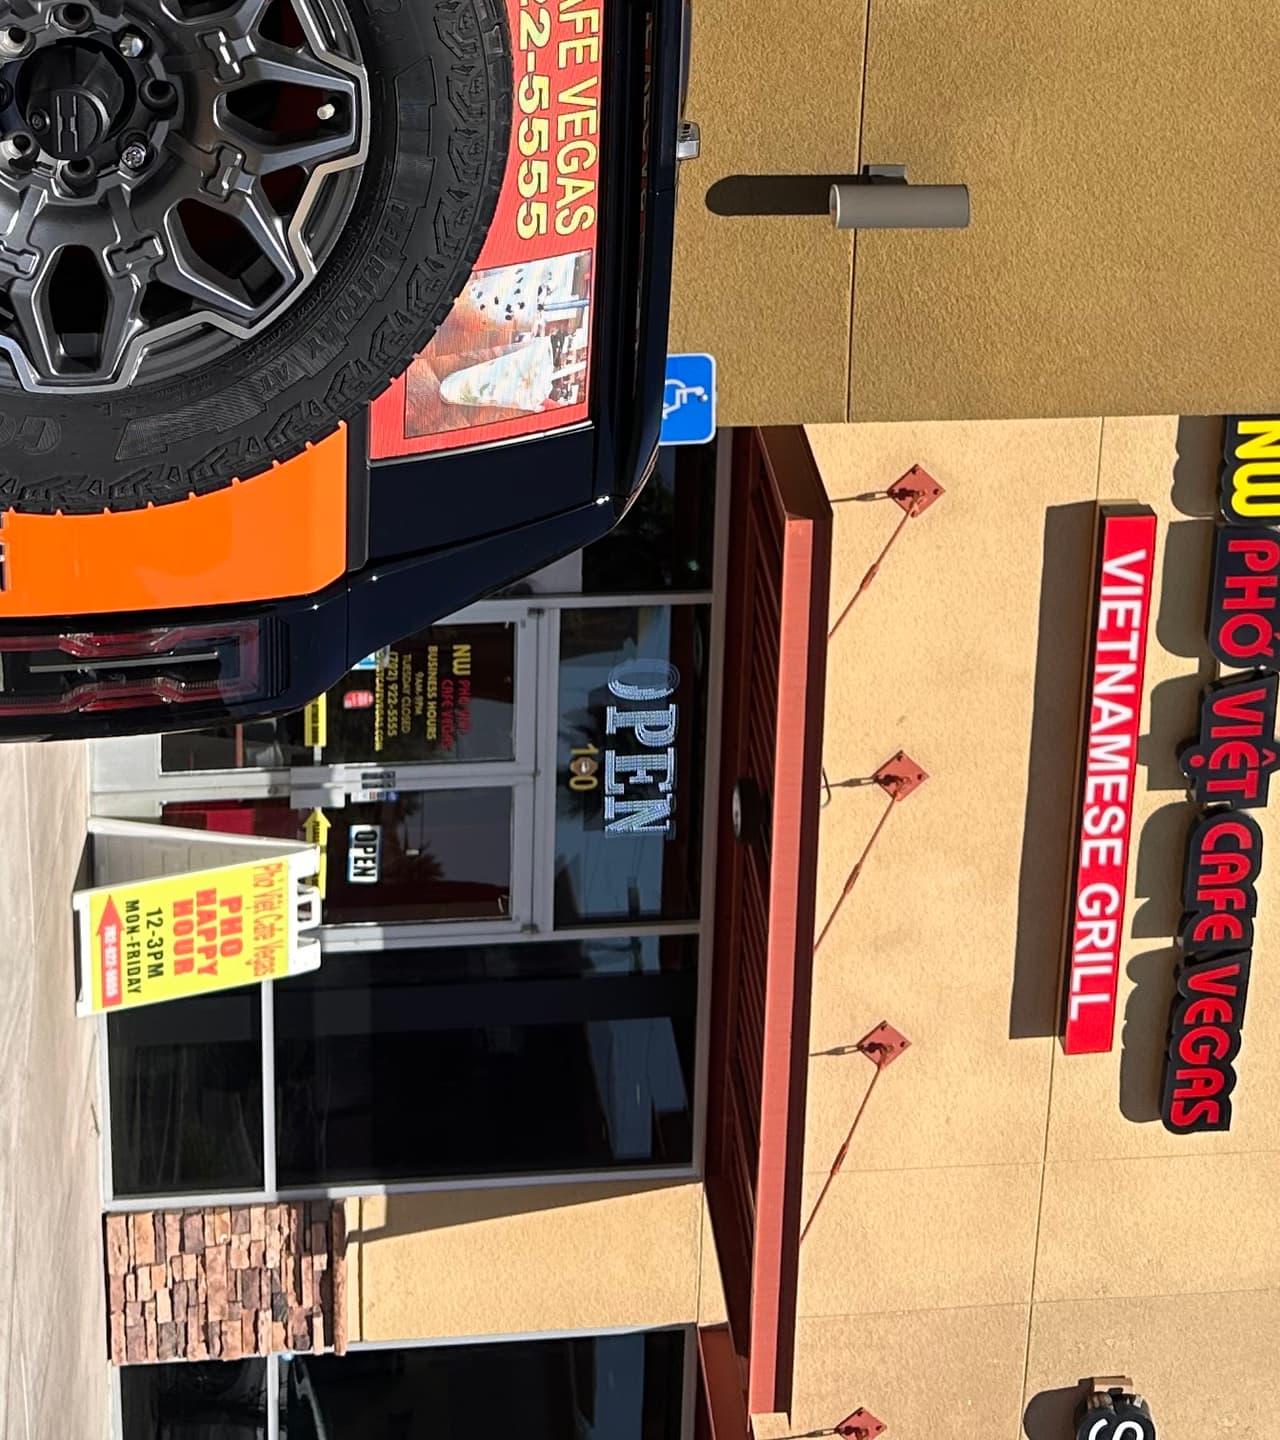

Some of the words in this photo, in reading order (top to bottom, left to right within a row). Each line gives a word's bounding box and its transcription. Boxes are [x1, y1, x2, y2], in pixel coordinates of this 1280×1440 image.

[554, 78, 598, 236] VEGAS
[386, 651, 399, 681] (702)
[402, 654, 412, 695] TUESDAY
[427, 645, 439, 699] BUSINESS
[452, 644, 471, 676] NW
[387, 683, 398, 737] 922-5555
[401, 696, 411, 734] CLOSED
[441, 679, 454, 707] CAFE
[1080, 549, 1147, 866] VIETNAMESE
[426, 701, 437, 740] HOURS
[441, 709, 454, 751] VEGAS
[604, 659, 680, 834] OPEN
[1189, 687, 1276, 800] VIỆT
[568, 743, 599, 791] 100
[352, 829, 378, 878] OPEN
[1193, 815, 1253, 942] CAFE
[125, 900, 141, 994] MON-FRIDAY
[145, 907, 164, 980] 12-3PM
[172, 897, 194, 976] HOUR
[196, 887, 218, 976] HAPPY
[219, 895, 243, 958] PHO
[253, 914, 284, 940] Cafe
[1068, 882, 1119, 1021] GRILL
[245, 940, 284, 977] Vegas
[1168, 962, 1241, 1128] VEGAS
